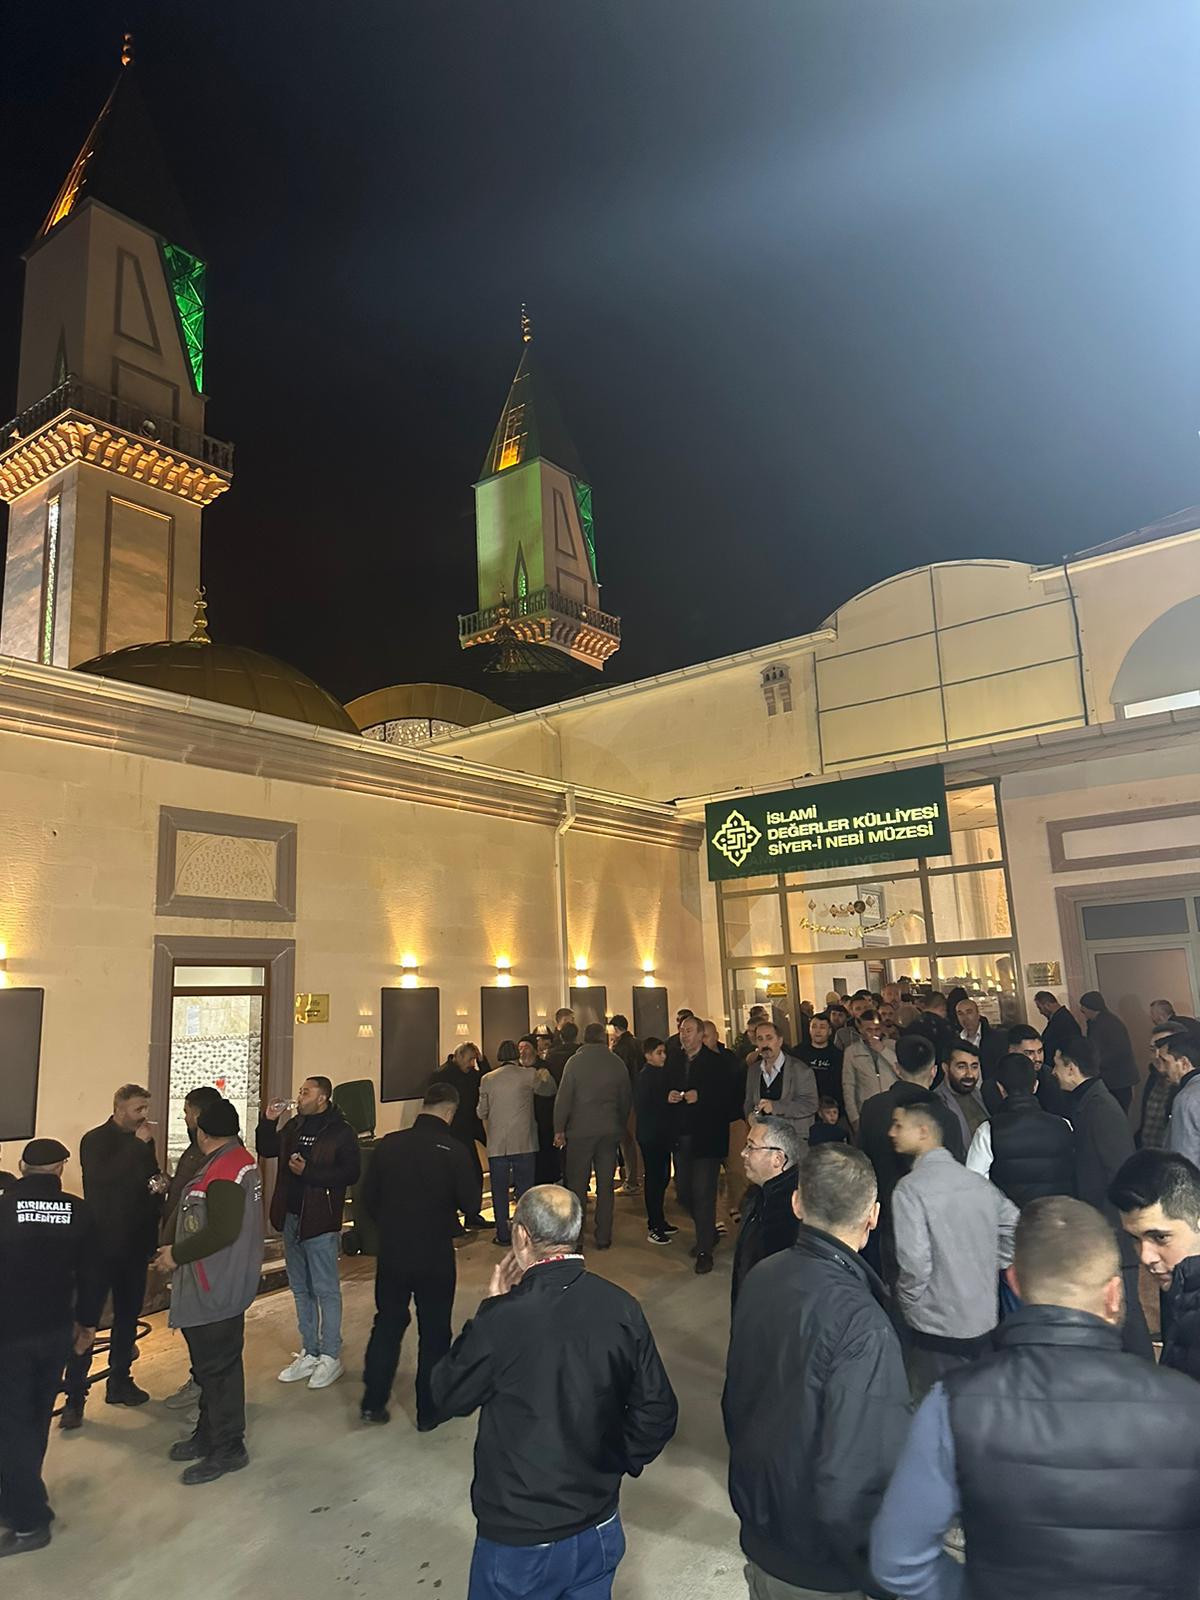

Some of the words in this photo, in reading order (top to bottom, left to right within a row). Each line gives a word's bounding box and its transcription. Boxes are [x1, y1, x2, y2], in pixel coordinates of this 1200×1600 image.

[767, 804, 817, 825] İSLAMİ
[768, 818, 849, 841] DEĞERLER
[853, 803, 939, 829] KÜLLİYESİ
[769, 838, 822, 856] SİYER-İ
[826, 830, 864, 849] NEBİ
[868, 820, 934, 845] MÜZESİ
[17, 1200, 72, 1211] KIRIKKALE
[17, 1212, 71, 1224] BELEDİYESİ
